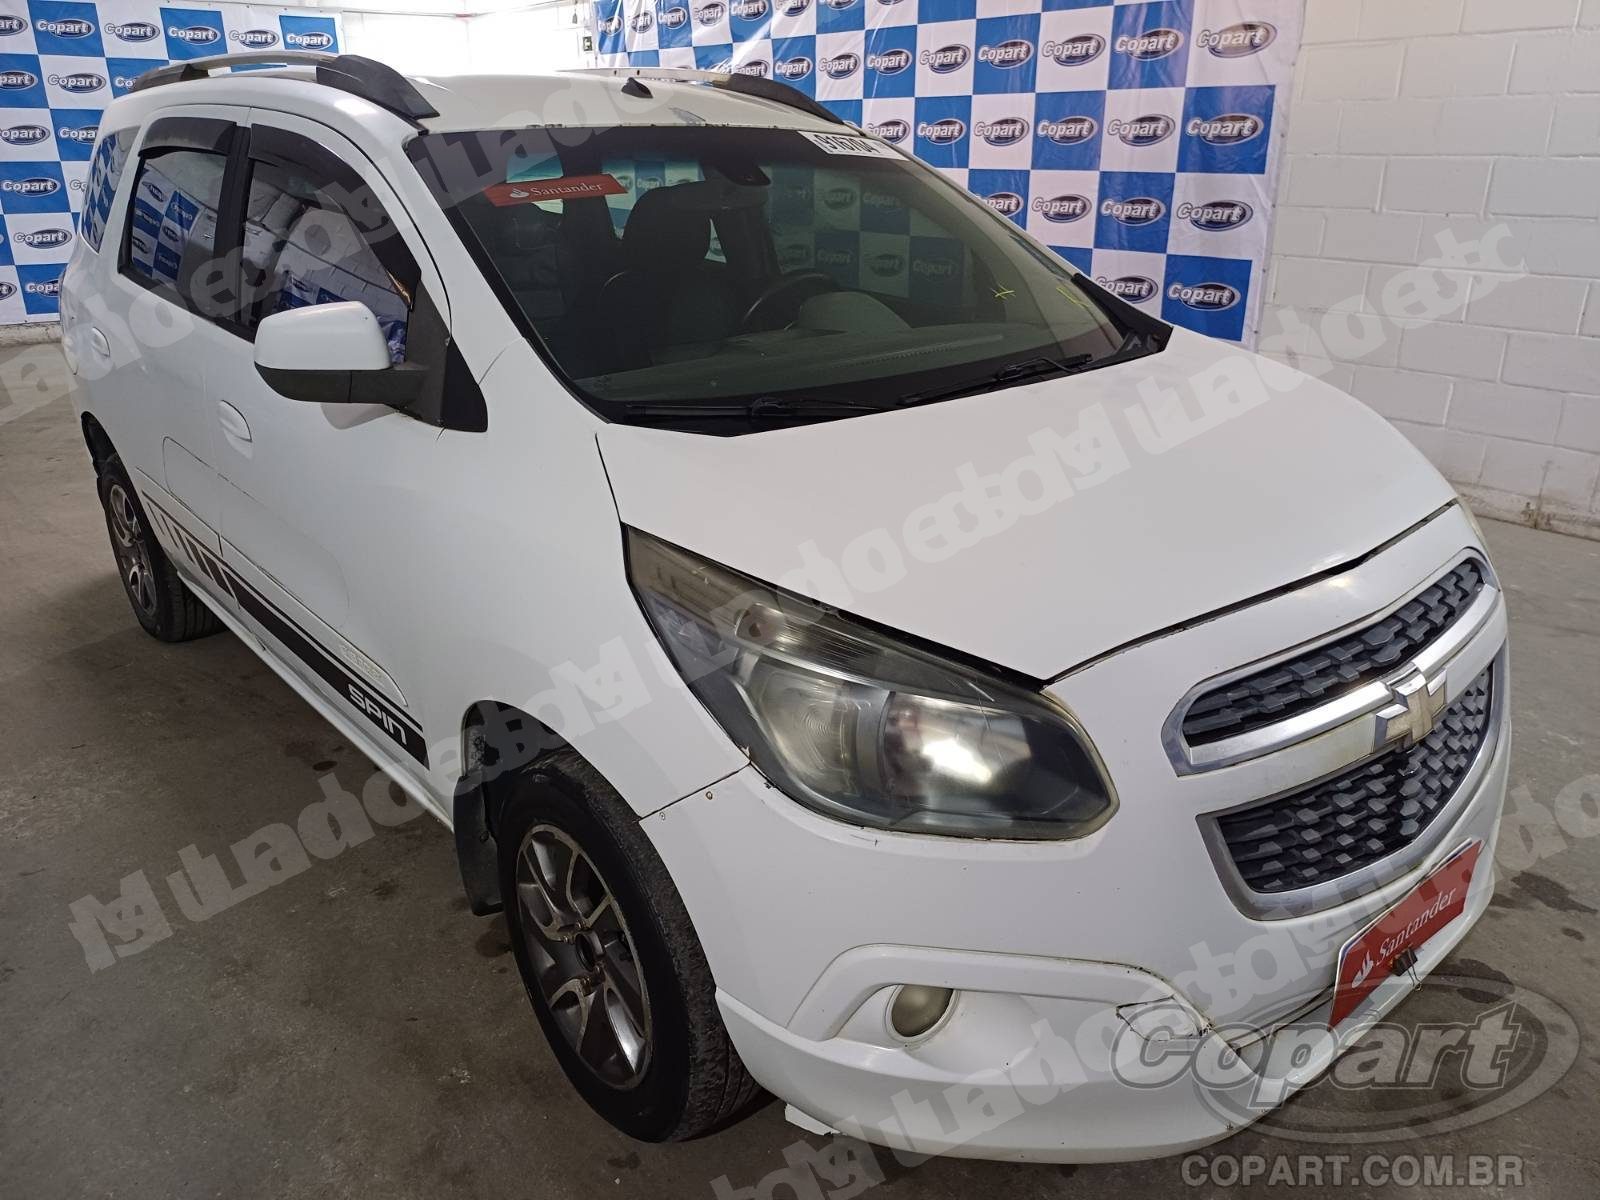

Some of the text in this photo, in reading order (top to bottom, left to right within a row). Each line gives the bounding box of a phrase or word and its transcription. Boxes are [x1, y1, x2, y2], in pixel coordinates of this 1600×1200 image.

[37, 20, 88, 34] Copart
[104, 23, 153, 38] Copart
[168, 27, 215, 40] Copart
[230, 30, 273, 43] Copart
[287, 33, 328, 45] Copart
[1197, 27, 1265, 49] Copart
[1042, 40, 1097, 58] Copart
[1115, 35, 1175, 56] Copart
[867, 54, 907, 70] Copart
[920, 49, 963, 67] Copart
[978, 46, 1026, 65] Copart
[775, 61, 807, 78] Copart
[819, 57, 855, 73] Copart
[49, 74, 98, 89] Copart
[60, 127, 97, 140] Copa
[917, 122, 960, 139] Copart
[974, 122, 1023, 138] Copart
[1037, 120, 1091, 139] Copart
[1108, 119, 1167, 139] Copart
[1187, 118, 1253, 138] Copart
[2, 180, 53, 193] Copart
[531, 183, 602, 196] Santander
[1032, 198, 1084, 215] Copart
[1102, 200, 1158, 218] Copart
[1177, 202, 1242, 224] Copart
[14, 231, 65, 244] Copart
[1168, 283, 1233, 305] Copart
[1376, 888, 1456, 966] Santander
